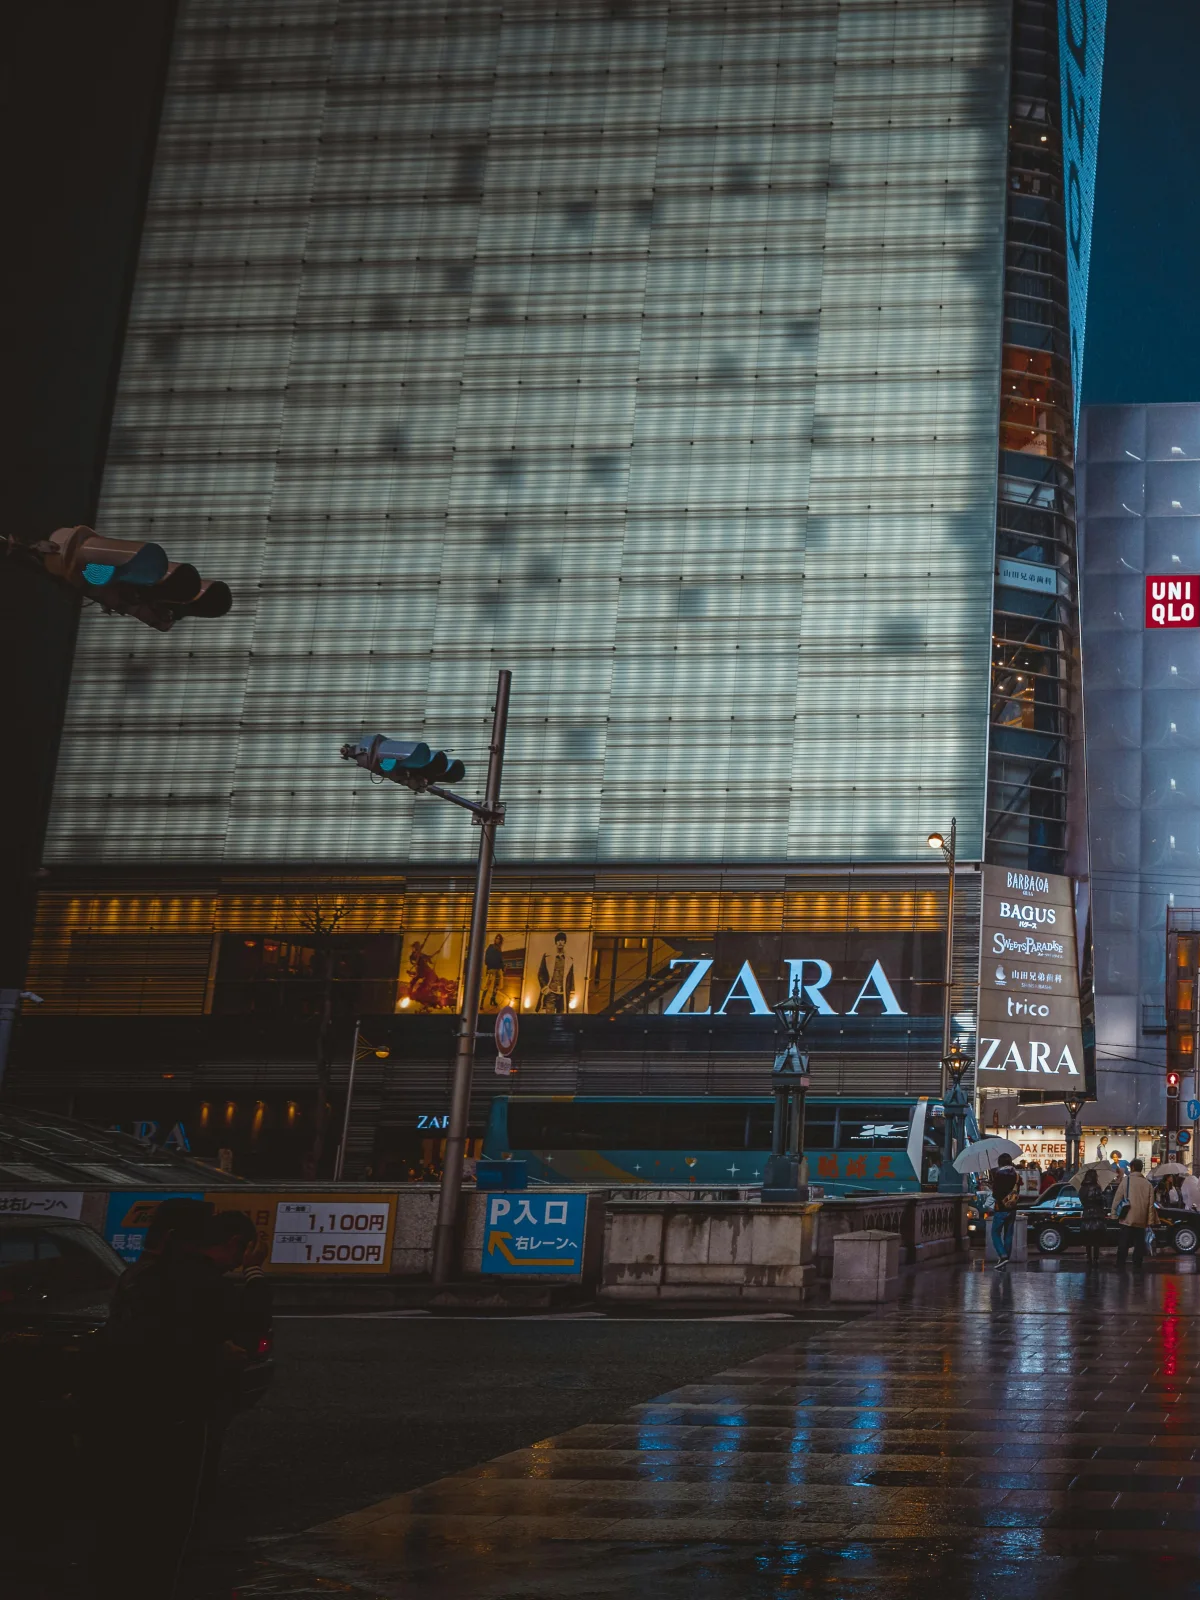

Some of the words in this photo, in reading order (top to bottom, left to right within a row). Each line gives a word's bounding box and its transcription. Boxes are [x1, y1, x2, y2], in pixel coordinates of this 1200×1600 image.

[1152, 581, 1191, 601] UNI
[1152, 603, 1195, 625] QLO
[1007, 871, 1049, 894] BARBACOA
[999, 902, 1056, 924] BAGUS
[664, 958, 909, 1016] ZARA
[1007, 996, 1050, 1017] trico
[977, 1037, 1081, 1075] ZARA
[1020, 1143, 1038, 1153] TAX
[1041, 1143, 1067, 1153] FREE
[309, 1214, 385, 1233] 1,100円
[305, 1244, 382, 1263] 1,500円
[515, 1236, 578, 1254] 右レーンへ
